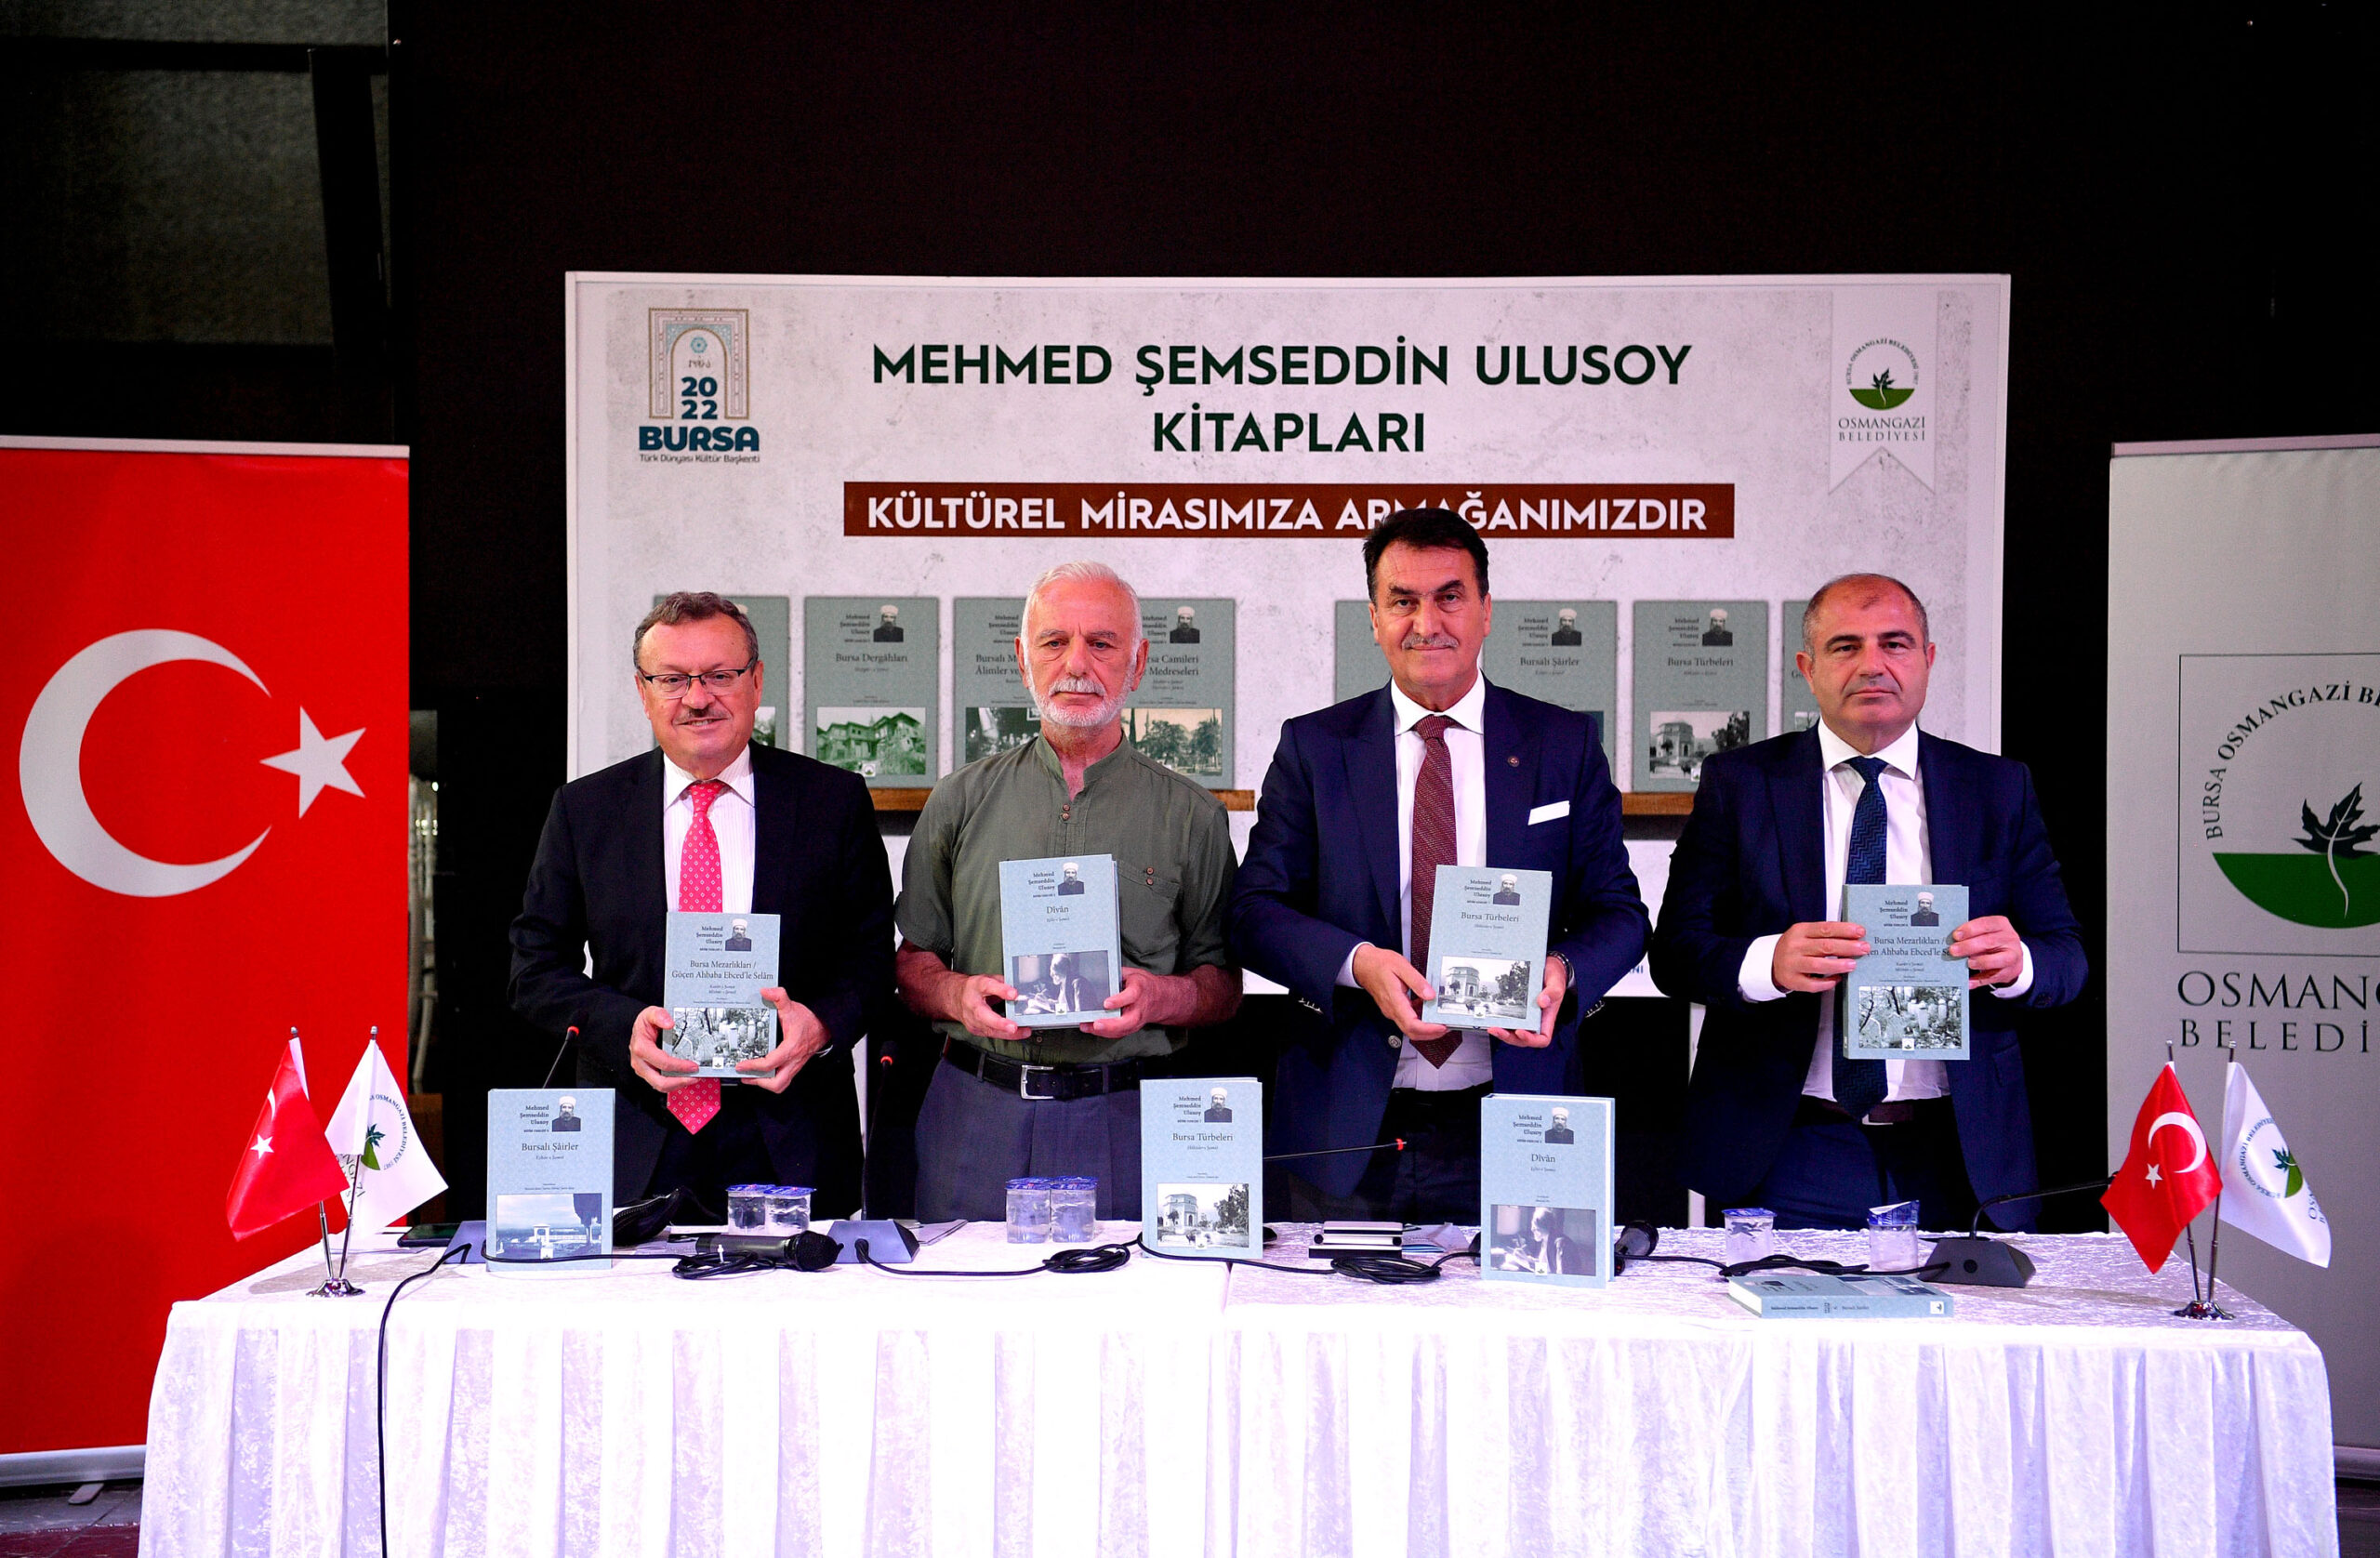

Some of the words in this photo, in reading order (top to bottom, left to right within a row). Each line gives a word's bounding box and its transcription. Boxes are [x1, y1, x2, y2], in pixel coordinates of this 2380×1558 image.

[874, 344, 1113, 385] MEHMED
[1134, 336, 1448, 397] ŞEMSEDDİN
[1476, 345, 1692, 386] ULUSOY
[681, 376, 718, 397] 20
[681, 400, 718, 420] 22
[1154, 403, 1424, 453] KİTAPLARI
[1838, 416, 1925, 429] OSMANGAZİ
[639, 426, 760, 452] BURSA
[1839, 430, 1925, 442] BELEDİYESİ
[640, 454, 658, 463] Türk
[660, 454, 694, 465] Dünyası
[695, 454, 721, 463] Kültür
[723, 454, 760, 466] Başkenti
[867, 490, 1065, 529] KÜLTÜREL
[1081, 490, 1324, 530] MİRASIMIZA
[1334, 490, 1708, 531] ARĞANIMIZDIR
[836, 654, 860, 662] Bursa
[1668, 656, 1692, 667] Bursa
[1150, 666, 1199, 676] Medreseleri
[2202, 764, 2228, 840] BURSA
[2216, 680, 2350, 761] OSMANGAZİ
[1461, 911, 1483, 920] Bursa
[1483, 913, 1519, 922] Türbeleri
[1874, 936, 1895, 944] Bursa
[1897, 936, 1940, 944] Mezarlıkları
[1881, 947, 1909, 956] Ahbaba
[690, 959, 709, 968] Bursa
[710, 960, 752, 969] Mezarlıkları
[671, 970, 694, 979] Göçen
[695, 970, 722, 979] Ahbaba
[752, 971, 774, 980] Selâm
[2177, 970, 2380, 1010] OSMAN
[1197, 1132, 1234, 1142] Türbeleri
[522, 1142, 550, 1151] Bursalı
